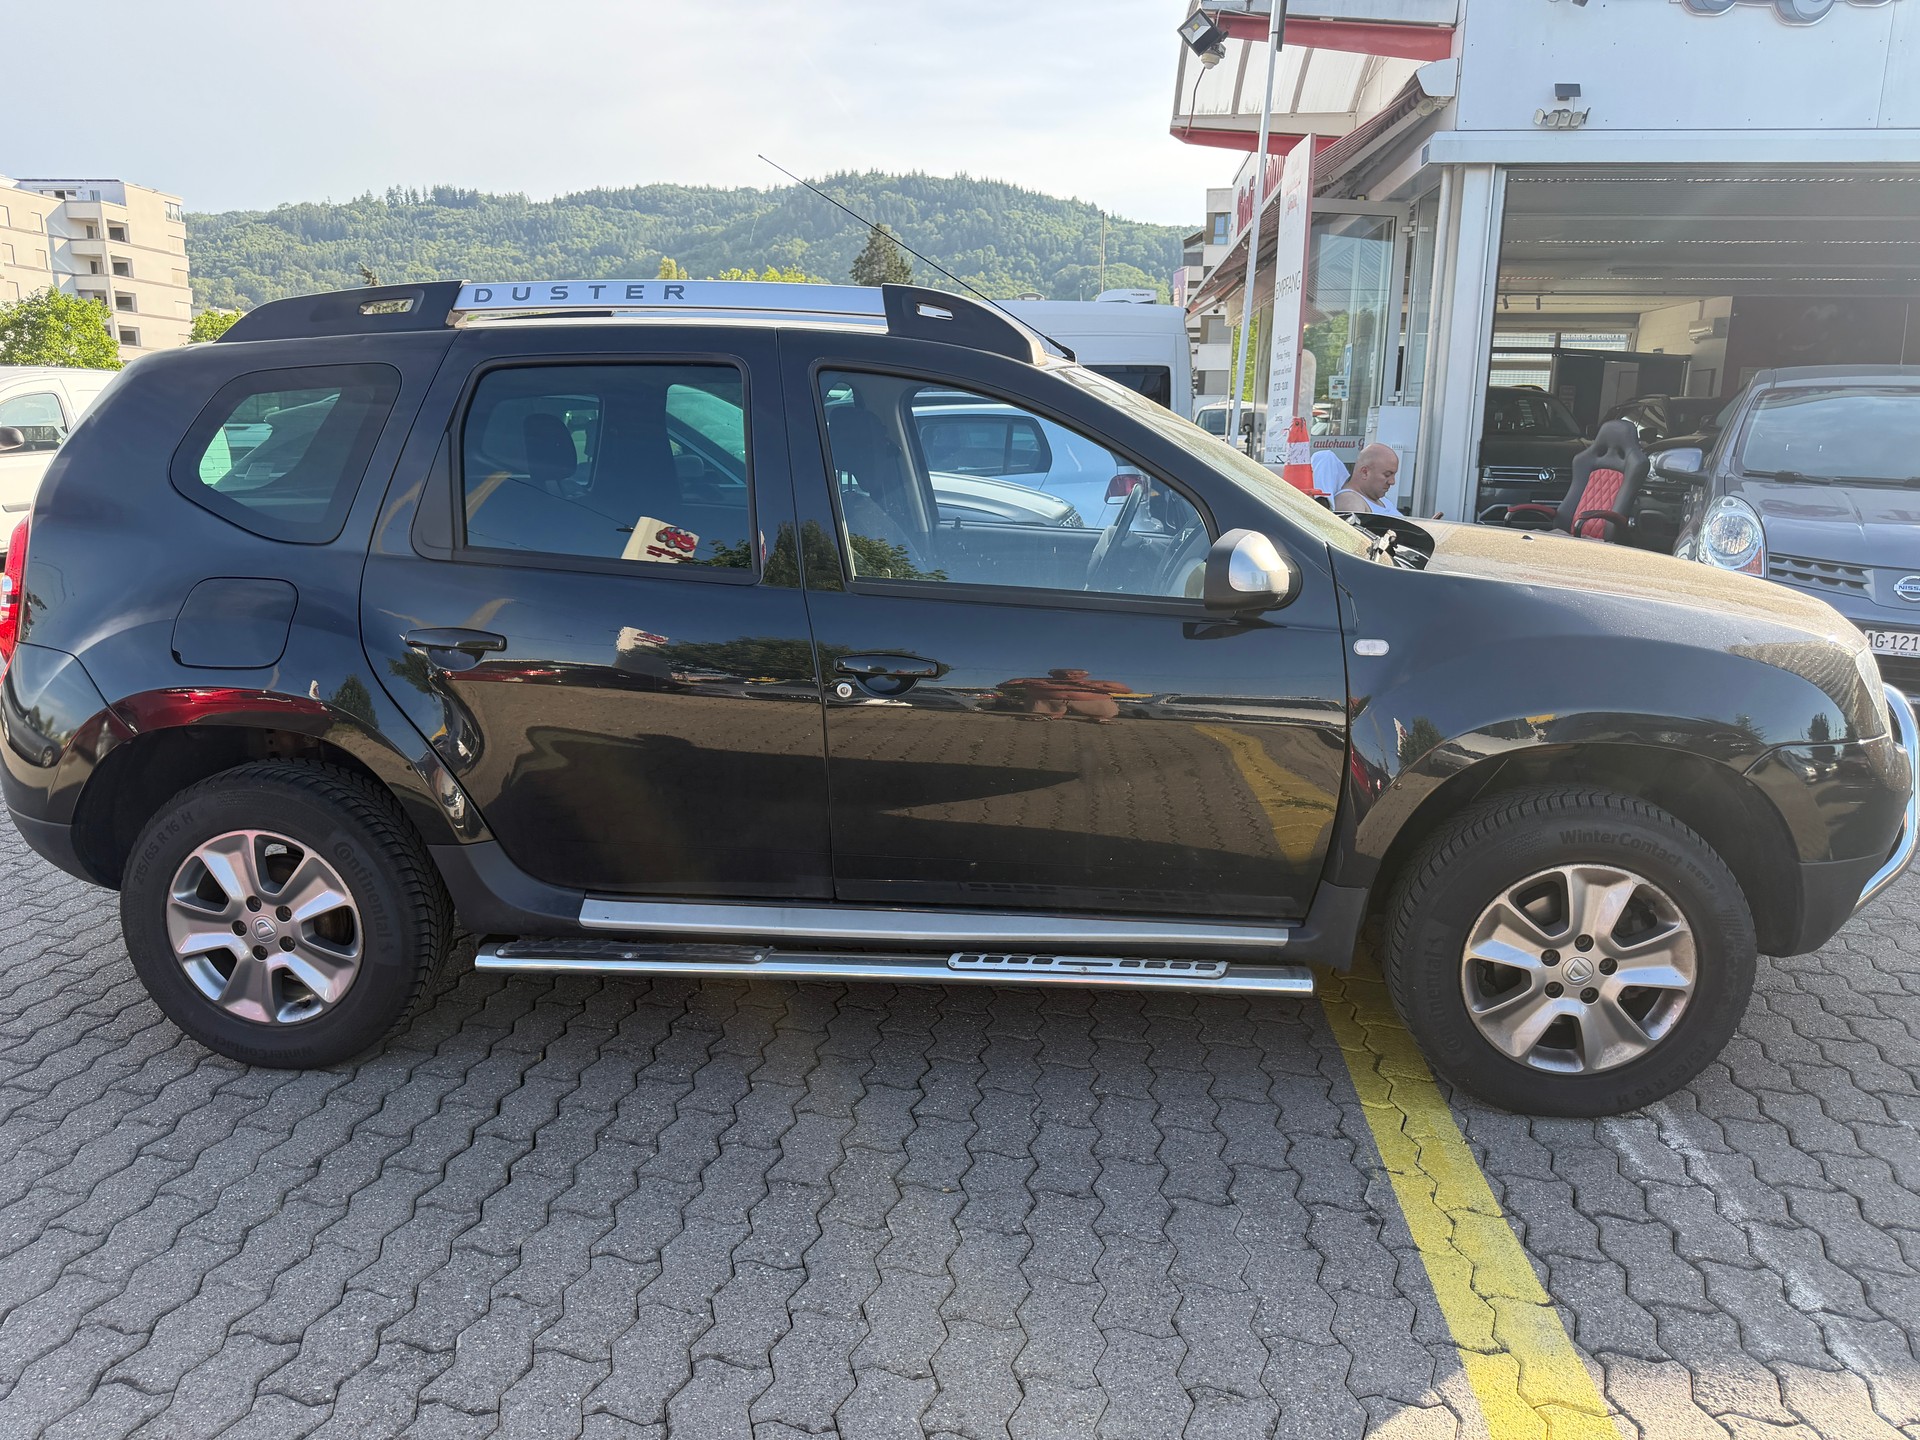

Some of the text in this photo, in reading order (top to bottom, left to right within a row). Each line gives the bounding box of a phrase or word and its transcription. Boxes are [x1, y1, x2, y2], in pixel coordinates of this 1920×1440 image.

[473, 284, 686, 303] DUSTER
[1275, 270, 1301, 300] EMPFANG
[1313, 438, 1356, 449] autohaus
[1559, 829, 1683, 867] WinterContact
[334, 841, 394, 938] Continental
